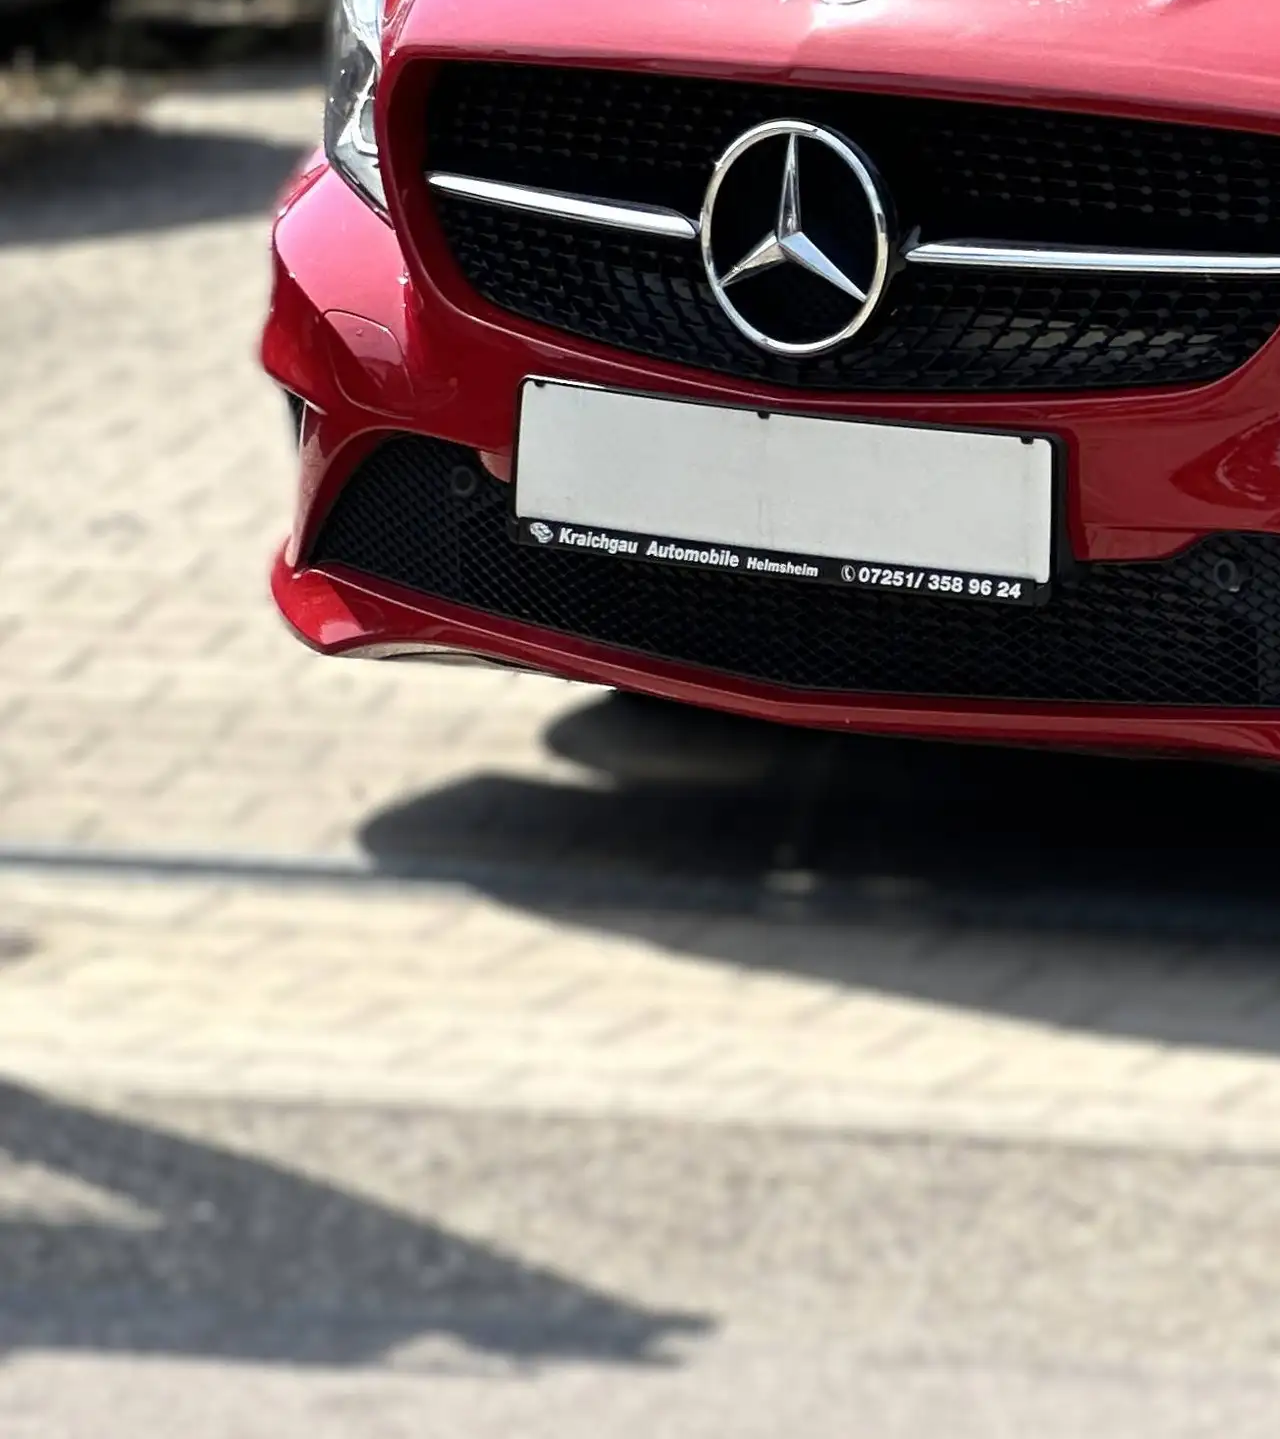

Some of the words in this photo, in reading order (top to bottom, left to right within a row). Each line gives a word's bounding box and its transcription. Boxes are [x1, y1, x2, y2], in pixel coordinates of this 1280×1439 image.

[558, 527, 638, 555] Kraichgau
[646, 540, 739, 568] Automobile
[747, 556, 819, 578] Helmsheim
[858, 566, 924, 589] 07251/
[928, 574, 963, 593] 358
[968, 578, 992, 596] 96
[996, 582, 1021, 599] 24
